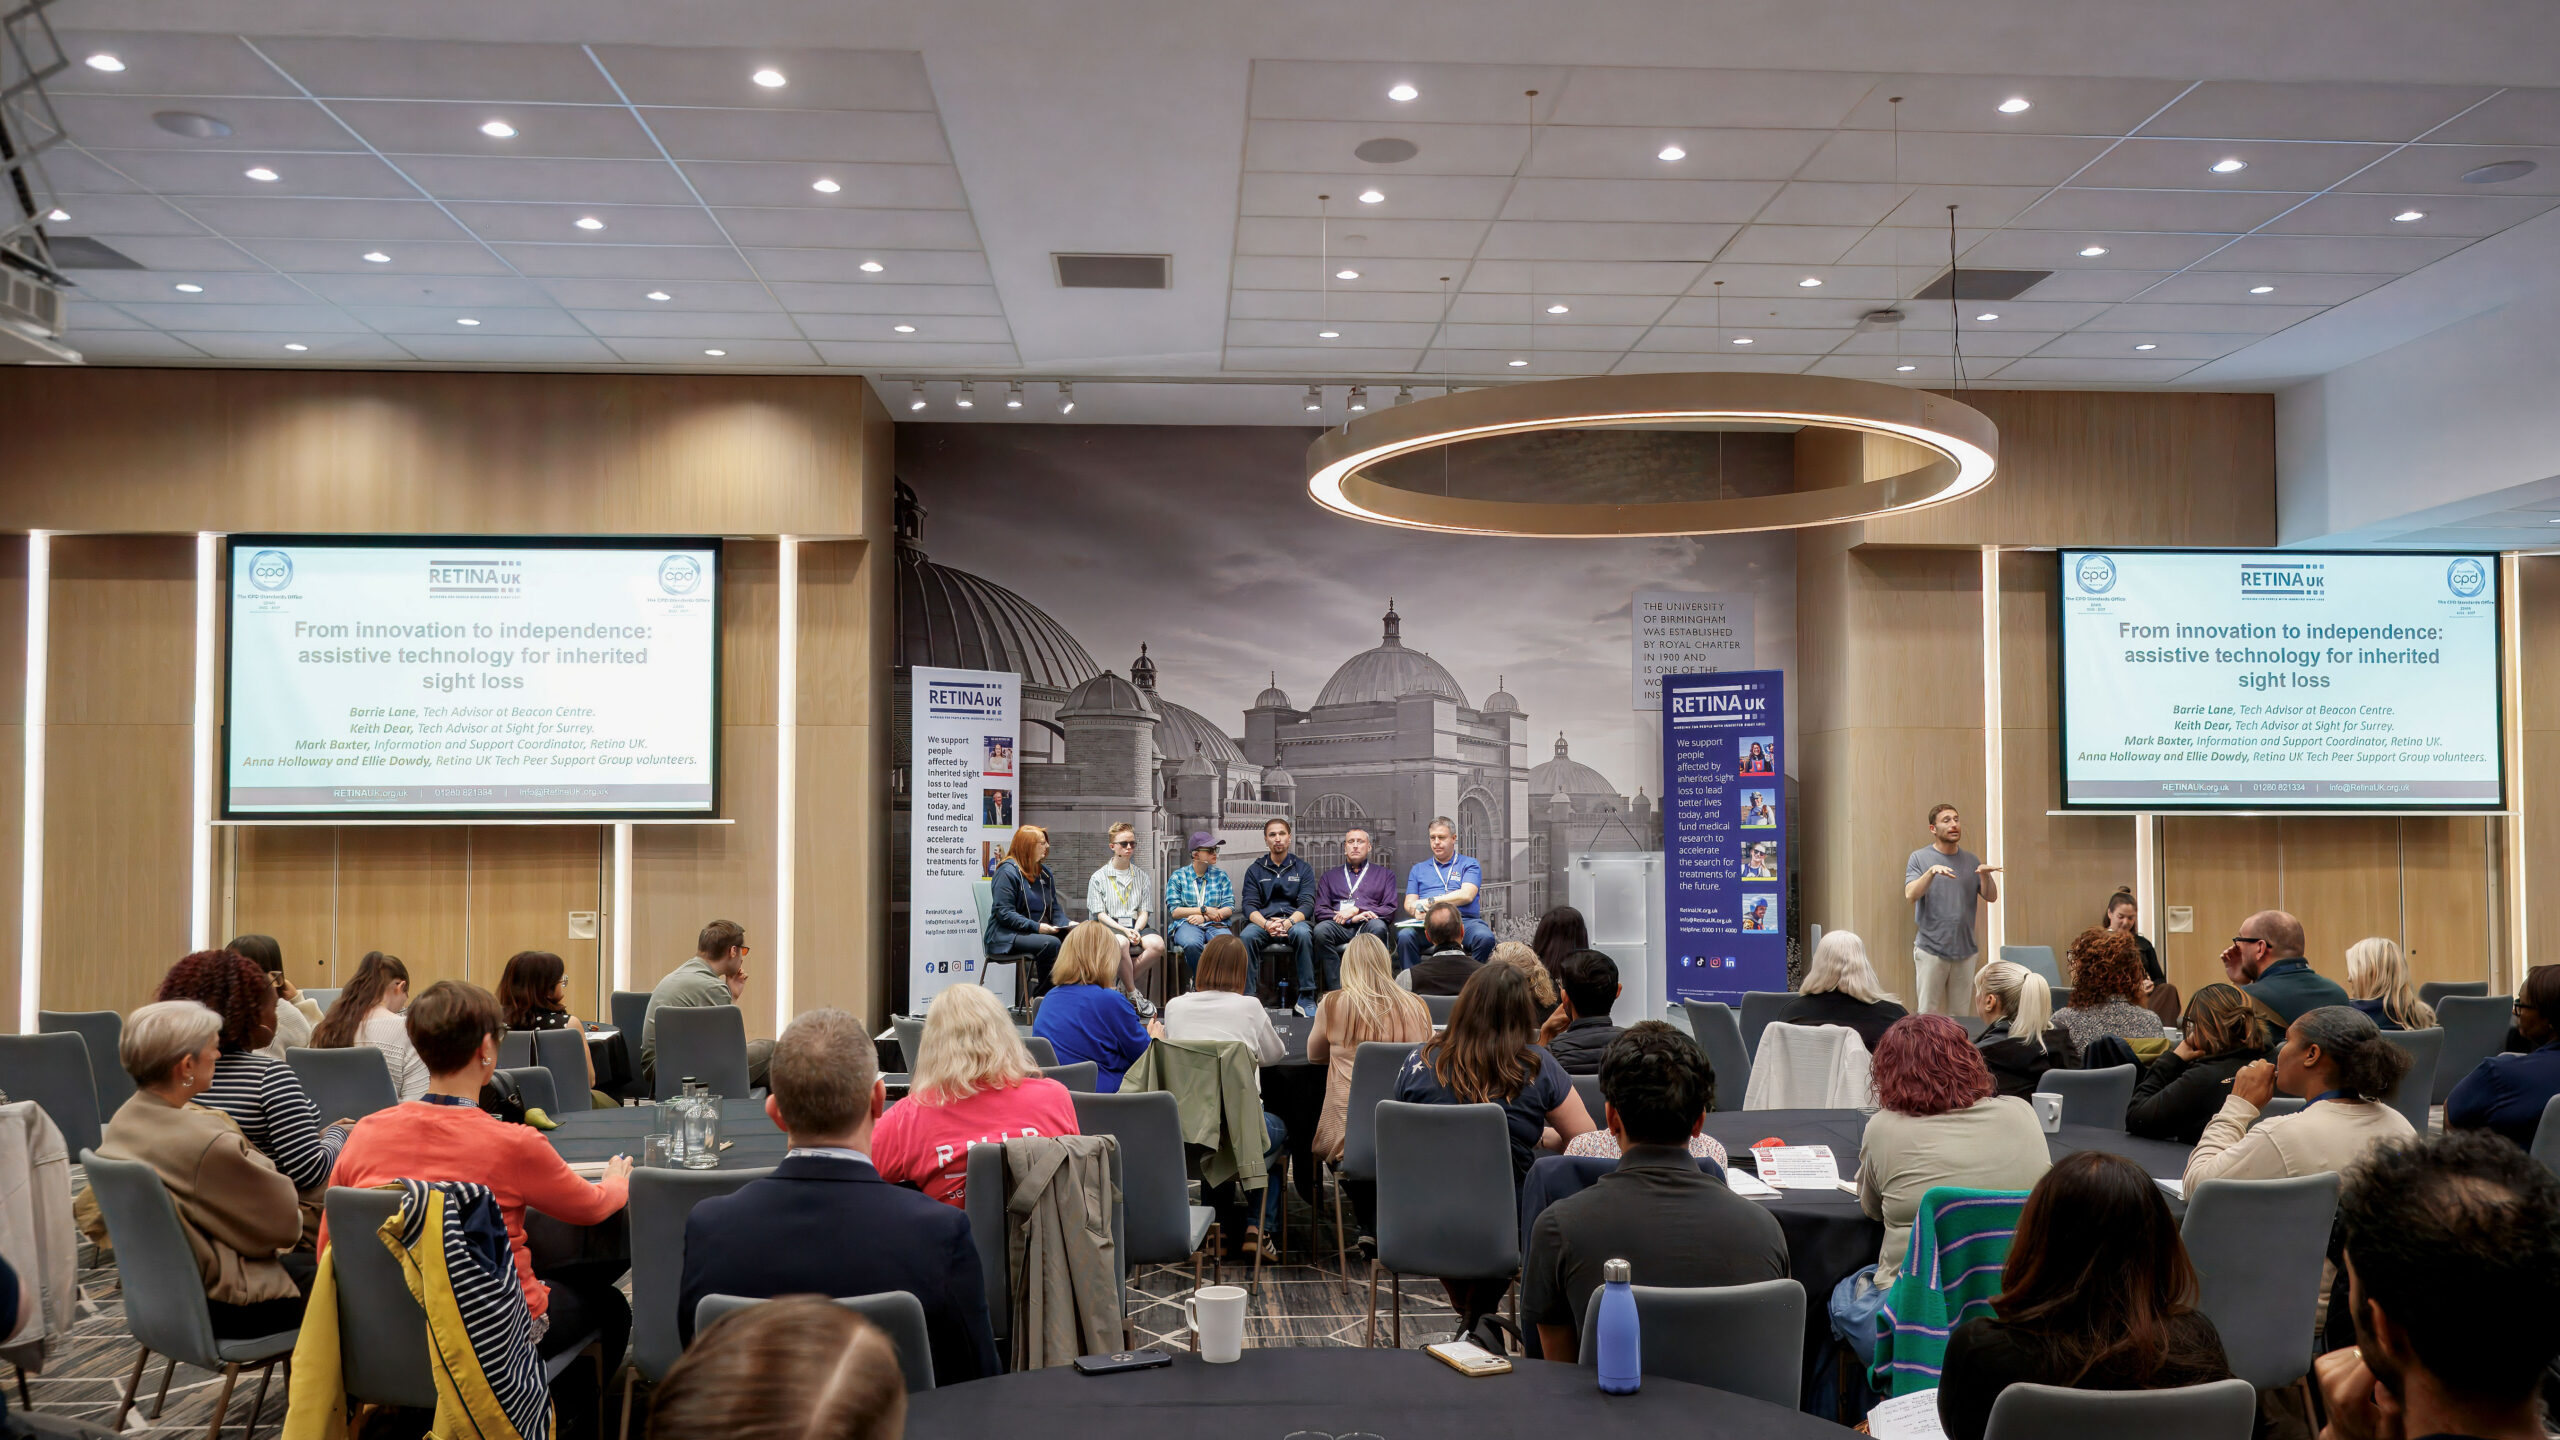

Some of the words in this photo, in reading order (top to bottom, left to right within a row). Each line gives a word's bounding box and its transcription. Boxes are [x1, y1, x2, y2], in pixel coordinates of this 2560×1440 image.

[256, 565, 285, 579] cpd
[430, 569, 498, 584] RETINA
[501, 574, 520, 584] UK
[665, 570, 694, 583] cpd
[2082, 568, 2109, 582] cpd
[2241, 572, 2304, 586] RETINA
[2306, 577, 2324, 587] UK
[2453, 572, 2478, 585] cpd
[1643, 602, 1663, 611] THE
[1666, 602, 1724, 611] UNIVERSITY
[1644, 615, 1657, 624] OF
[1660, 615, 1725, 624] BIRMINGHAM
[295, 621, 348, 638] From
[356, 621, 466, 639] innovation
[472, 623, 493, 638] to
[500, 622, 651, 643] independence:
[1643, 628, 1665, 636] WAS
[1670, 628, 1733, 636] ESTABLISHED
[2120, 622, 2169, 638] From
[2176, 622, 2276, 639] innovation
[2282, 624, 2301, 639] to
[2307, 623, 2442, 644] independence:
[1643, 640, 1655, 648] BY
[1659, 640, 1691, 649] ROYAL
[1694, 641, 1740, 649] CHARTER
[298, 647, 391, 664] assistive
[398, 647, 514, 668] technology
[521, 647, 550, 664] for
[557, 647, 647, 664] inherited
[1644, 653, 1655, 661] IN
[1660, 653, 1680, 661] 1900
[2125, 647, 2209, 663] assistive
[2215, 647, 2321, 667] technology
[2326, 648, 2353, 663] for
[2359, 648, 2439, 664] inherited
[1644, 666, 1652, 674] IS
[1656, 666, 1678, 674] ONE
[1681, 666, 1694, 674] OF
[1698, 666, 1718, 674] THE
[423, 672, 475, 693] sight
[482, 672, 524, 689] loss
[2239, 672, 2286, 691] sight
[2292, 672, 2330, 688] loss
[929, 689, 984, 706] RETINA
[987, 696, 1002, 707] UK
[1673, 695, 1742, 713] RETINA
[1744, 698, 1765, 710] UK
[349, 706, 386, 717] Barrie
[388, 707, 418, 718] Lane,
[424, 706, 448, 717] Tech
[450, 706, 494, 717] Advisor
[496, 707, 508, 717] at
[511, 707, 553, 717] Beacon
[556, 706, 595, 717] Centre.
[2173, 704, 2205, 714] Barrie
[2208, 705, 2236, 716] Lane,
[2240, 705, 2262, 714] Tech
[2264, 705, 2303, 715] Advisor
[2306, 706, 2316, 715] at
[2319, 705, 2356, 715] Beacon
[2359, 705, 2394, 715] Centre.
[2174, 720, 2201, 730] Keith
[2204, 720, 2232, 732] Dear,
[2236, 720, 2258, 730] Tech
[2260, 720, 2299, 730] Advisor
[2301, 722, 2312, 731] at
[2315, 720, 2340, 733] Sight
[2342, 720, 2358, 733] for
[2360, 721, 2394, 732] Surrey.
[941, 738, 969, 746] support
[1676, 739, 1690, 747] We
[1691, 739, 1723, 748] support
[2124, 736, 2154, 745] Mark
[2157, 736, 2194, 747] Baxter,
[2196, 735, 2258, 748] Information
[2260, 736, 2281, 746] and
[2282, 736, 2323, 748] Support
[2326, 736, 2388, 747] Coordinator,
[2391, 737, 2423, 746] Retina
[2426, 737, 2443, 746] UK.
[928, 747, 952, 756] people
[1677, 750, 1704, 760] people
[2078, 752, 2107, 761] Anna
[2110, 751, 2161, 763] Holloway
[2164, 751, 2184, 761] and
[2186, 751, 2208, 762] Ellie
[2210, 751, 2250, 764] Dowdy,
[2253, 752, 2286, 762] Retina
[2289, 752, 2304, 762] UK
[2306, 752, 2329, 762] Tech
[2331, 752, 2354, 762] Peer
[2356, 752, 2396, 764] Support
[2399, 752, 2430, 763] Group
[2433, 752, 2487, 762] volunteers.
[928, 758, 958, 766] affected
[960, 758, 968, 768] by
[1677, 762, 1709, 771] affected
[1711, 762, 1721, 772] by
[928, 769, 961, 777] inherited
[962, 770, 980, 779] sight
[1678, 774, 1713, 783] inherited
[1714, 773, 1734, 784] sight
[952, 780, 968, 788] lead
[928, 791, 950, 799] better
[1678, 787, 1694, 795] loss
[1705, 786, 1722, 794] lead
[928, 802, 950, 811] today,
[1678, 799, 1702, 807] better
[1704, 798, 1722, 806] lives
[1678, 810, 1702, 820] today,
[1704, 810, 1720, 818] and
[927, 824, 958, 832] research
[1679, 822, 1697, 831] fund
[1698, 822, 1730, 830] medical
[1679, 834, 1714, 842] research
[927, 846, 939, 854] the
[940, 846, 964, 854] search
[965, 846, 976, 854] for
[1679, 846, 1720, 854] accelerate
[1679, 858, 1692, 866] the
[1694, 858, 1720, 866] search
[1723, 858, 1734, 866] for
[926, 868, 939, 876] the
[940, 868, 964, 876] future.
[1725, 869, 1737, 878] for
[1679, 882, 1693, 890] the
[1694, 882, 1720, 890] future.
